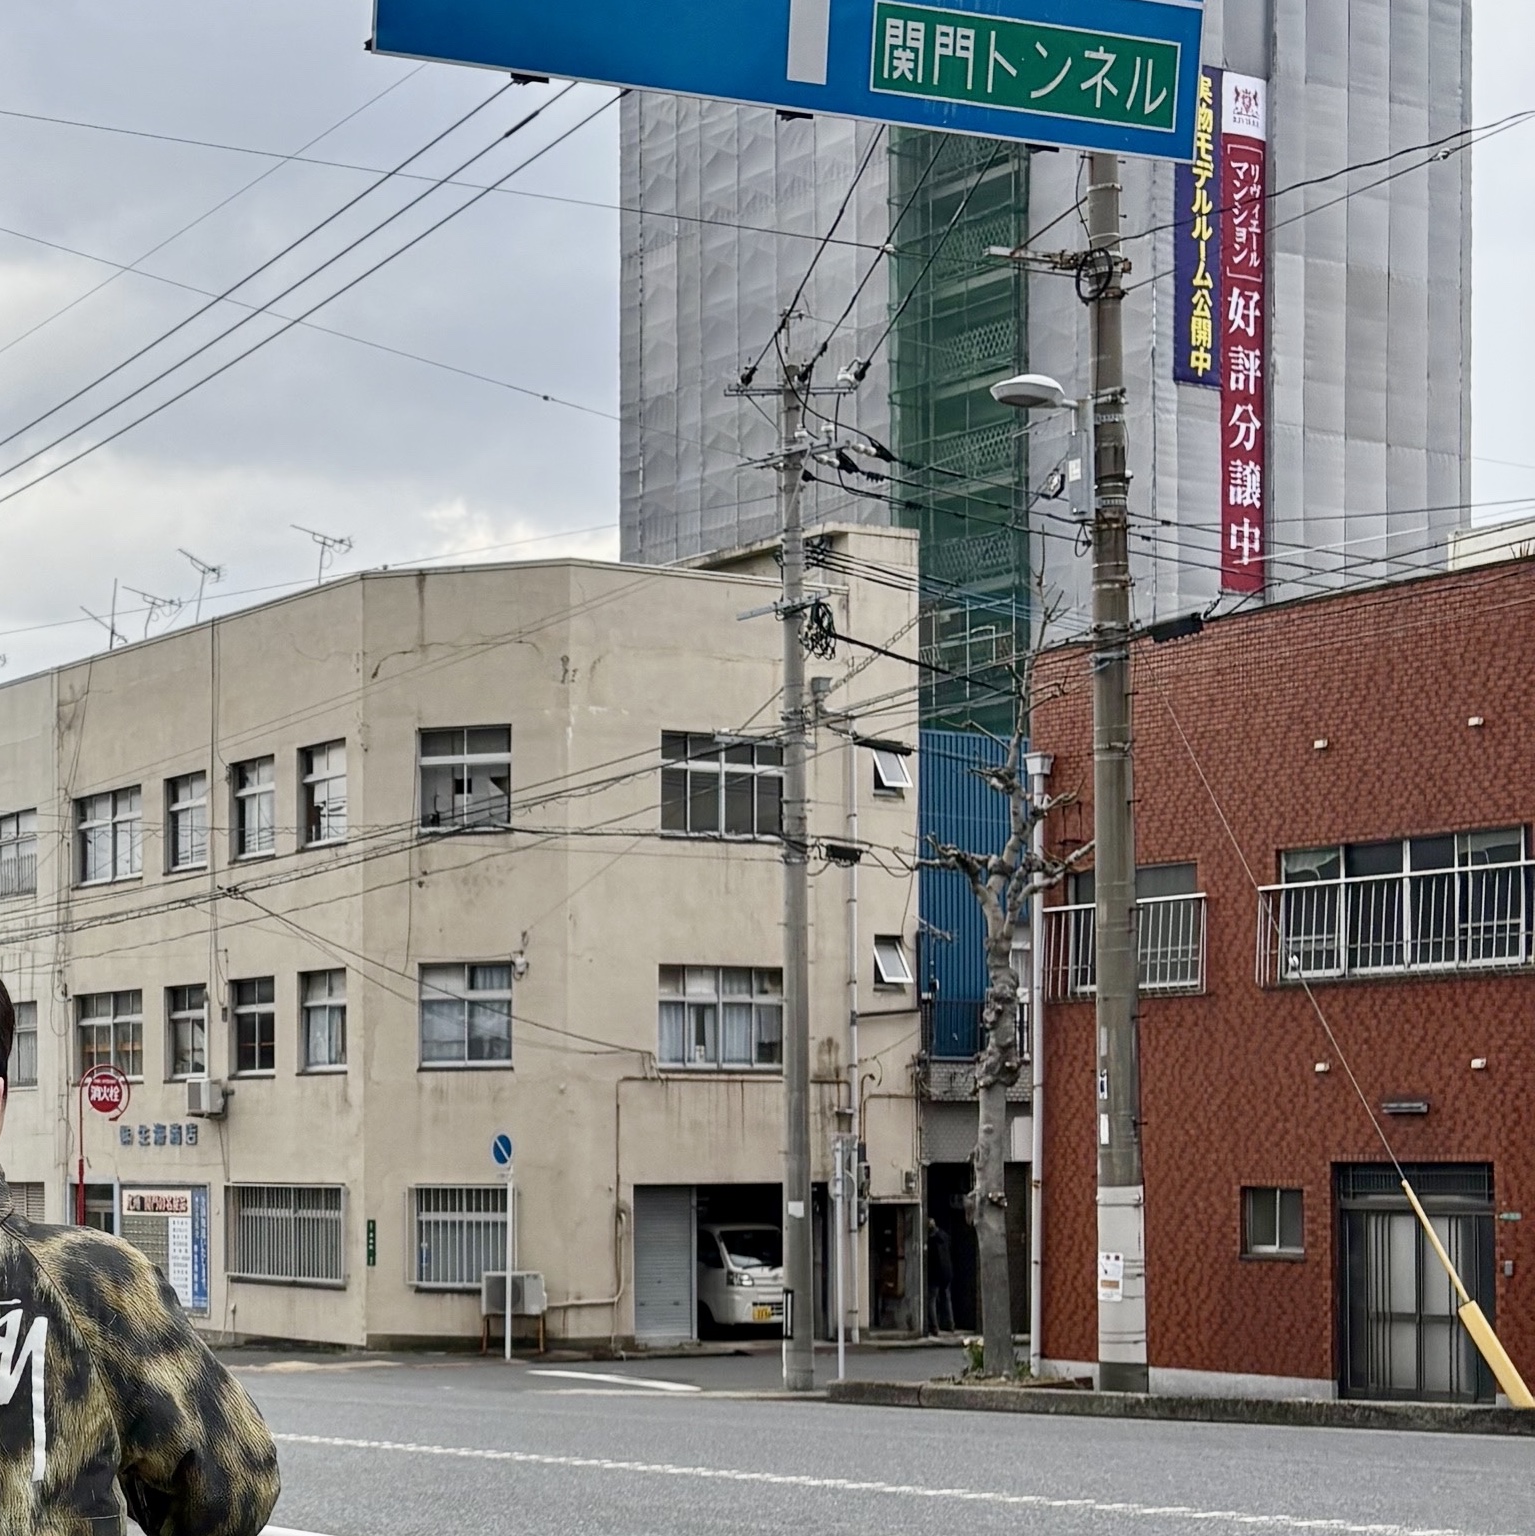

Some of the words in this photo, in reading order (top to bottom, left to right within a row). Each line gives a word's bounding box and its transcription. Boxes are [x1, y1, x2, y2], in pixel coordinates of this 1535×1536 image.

[883, 18, 1167, 115] 関門トンネル
[1230, 161, 1249, 264] マンション
[1227, 286, 1261, 566] 好評分譲中
[90, 1085, 120, 1102] 消火栓
